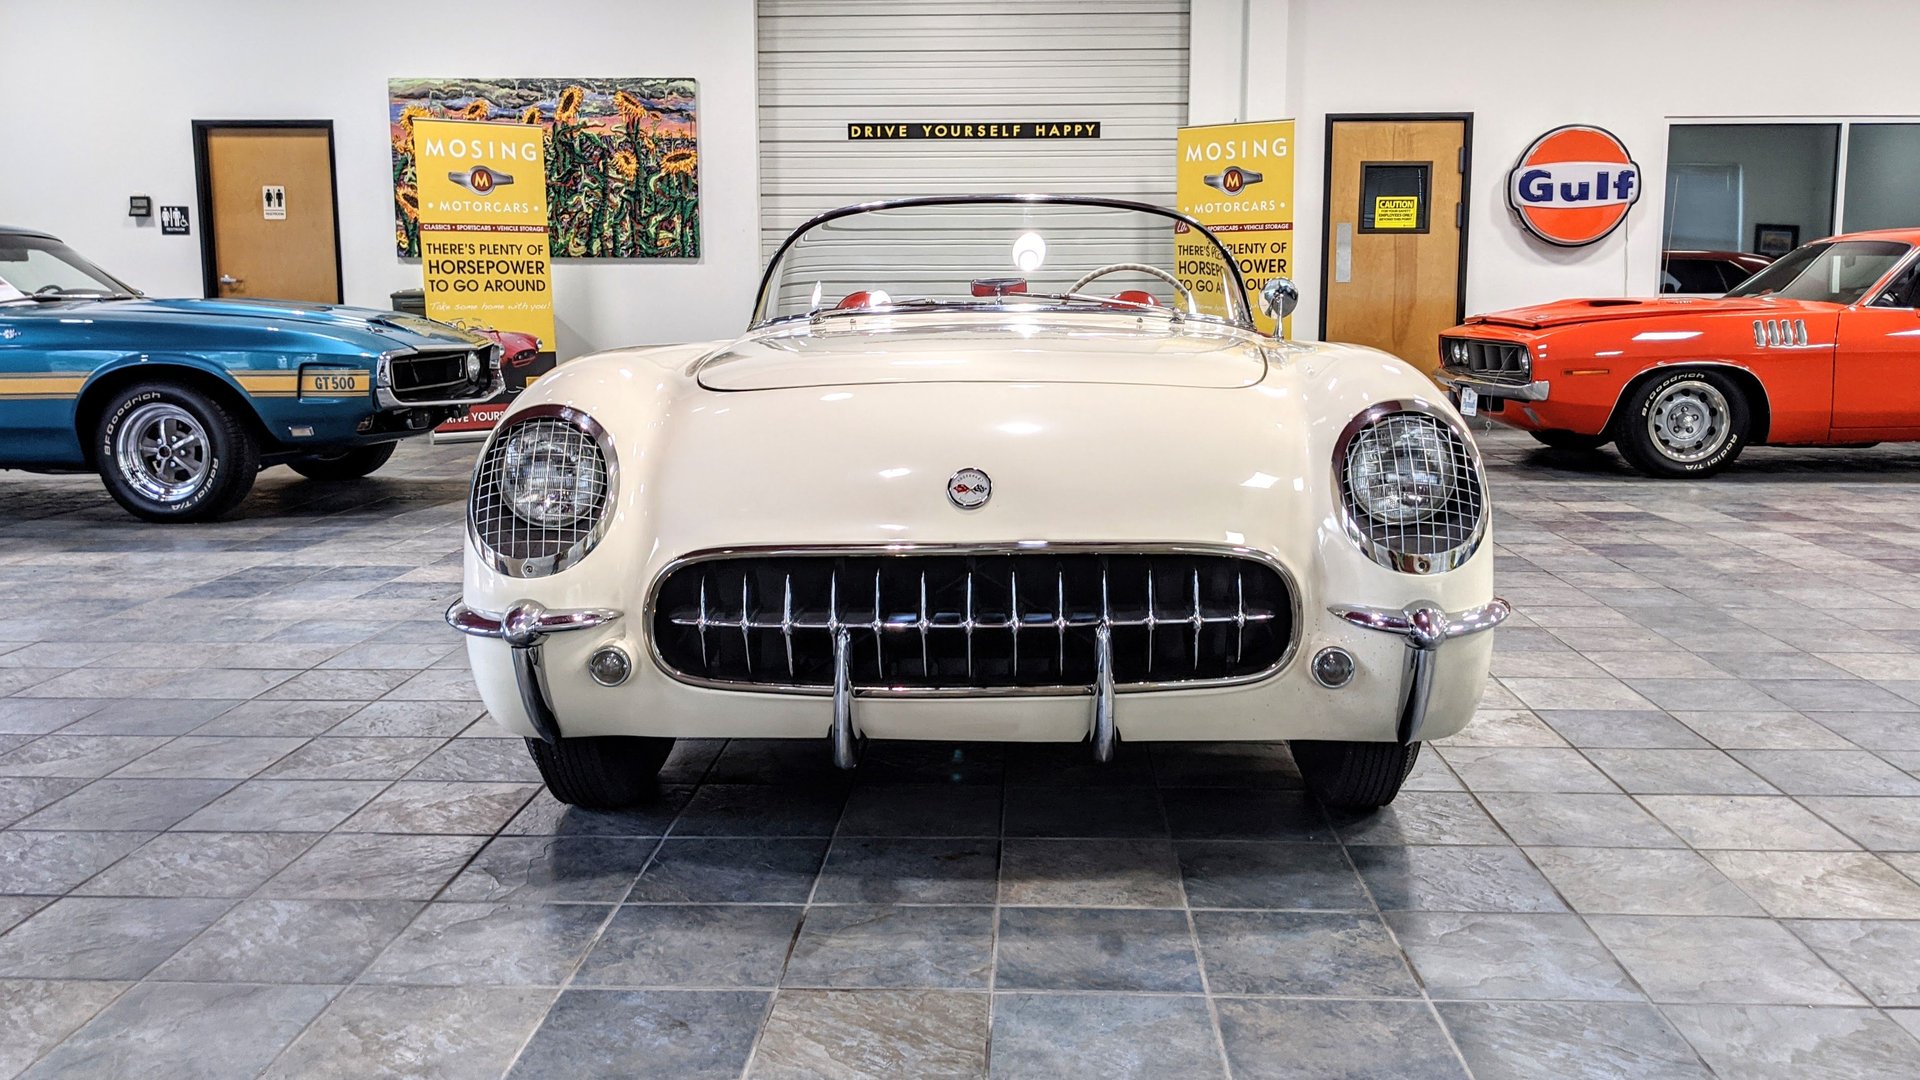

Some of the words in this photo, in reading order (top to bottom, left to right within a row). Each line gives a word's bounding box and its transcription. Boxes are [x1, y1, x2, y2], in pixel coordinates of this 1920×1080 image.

[851, 125, 907, 138] DRIVE
[922, 124, 1021, 137] YOURSELF
[1035, 124, 1096, 136] HAPPY
[425, 138, 537, 161] MOSING
[1185, 138, 1287, 162] MOSING
[474, 173, 489, 187] M
[1226, 174, 1240, 187] M
[1519, 169, 1635, 202] Gulf
[439, 201, 529, 213] MOTORCARS
[1194, 200, 1276, 214] MOTORCARS
[1379, 200, 1414, 208] CAUTION
[426, 243, 475, 255] THERE'S
[479, 244, 523, 256] PLENTY
[526, 244, 544, 256] OF
[1178, 244, 1210, 257] THERE'S
[1227, 242, 1267, 254] PLENTY
[1270, 242, 1287, 254] OF
[428, 260, 545, 275] HORSEPOWER
[428, 280, 449, 292] TO
[453, 280, 479, 292] GO
[483, 280, 546, 292] AROUND
[1196, 280, 1214, 292] GO
[430, 302, 451, 311] Take
[481, 302, 504, 311] home
[508, 302, 528, 310] with
[530, 302, 551, 312] you!
[1642, 372, 1705, 416] BFGoodrich
[104, 392, 160, 456] BFGoodrich
[1707, 433, 1738, 466] Radial
[194, 458, 218, 502] Radial
